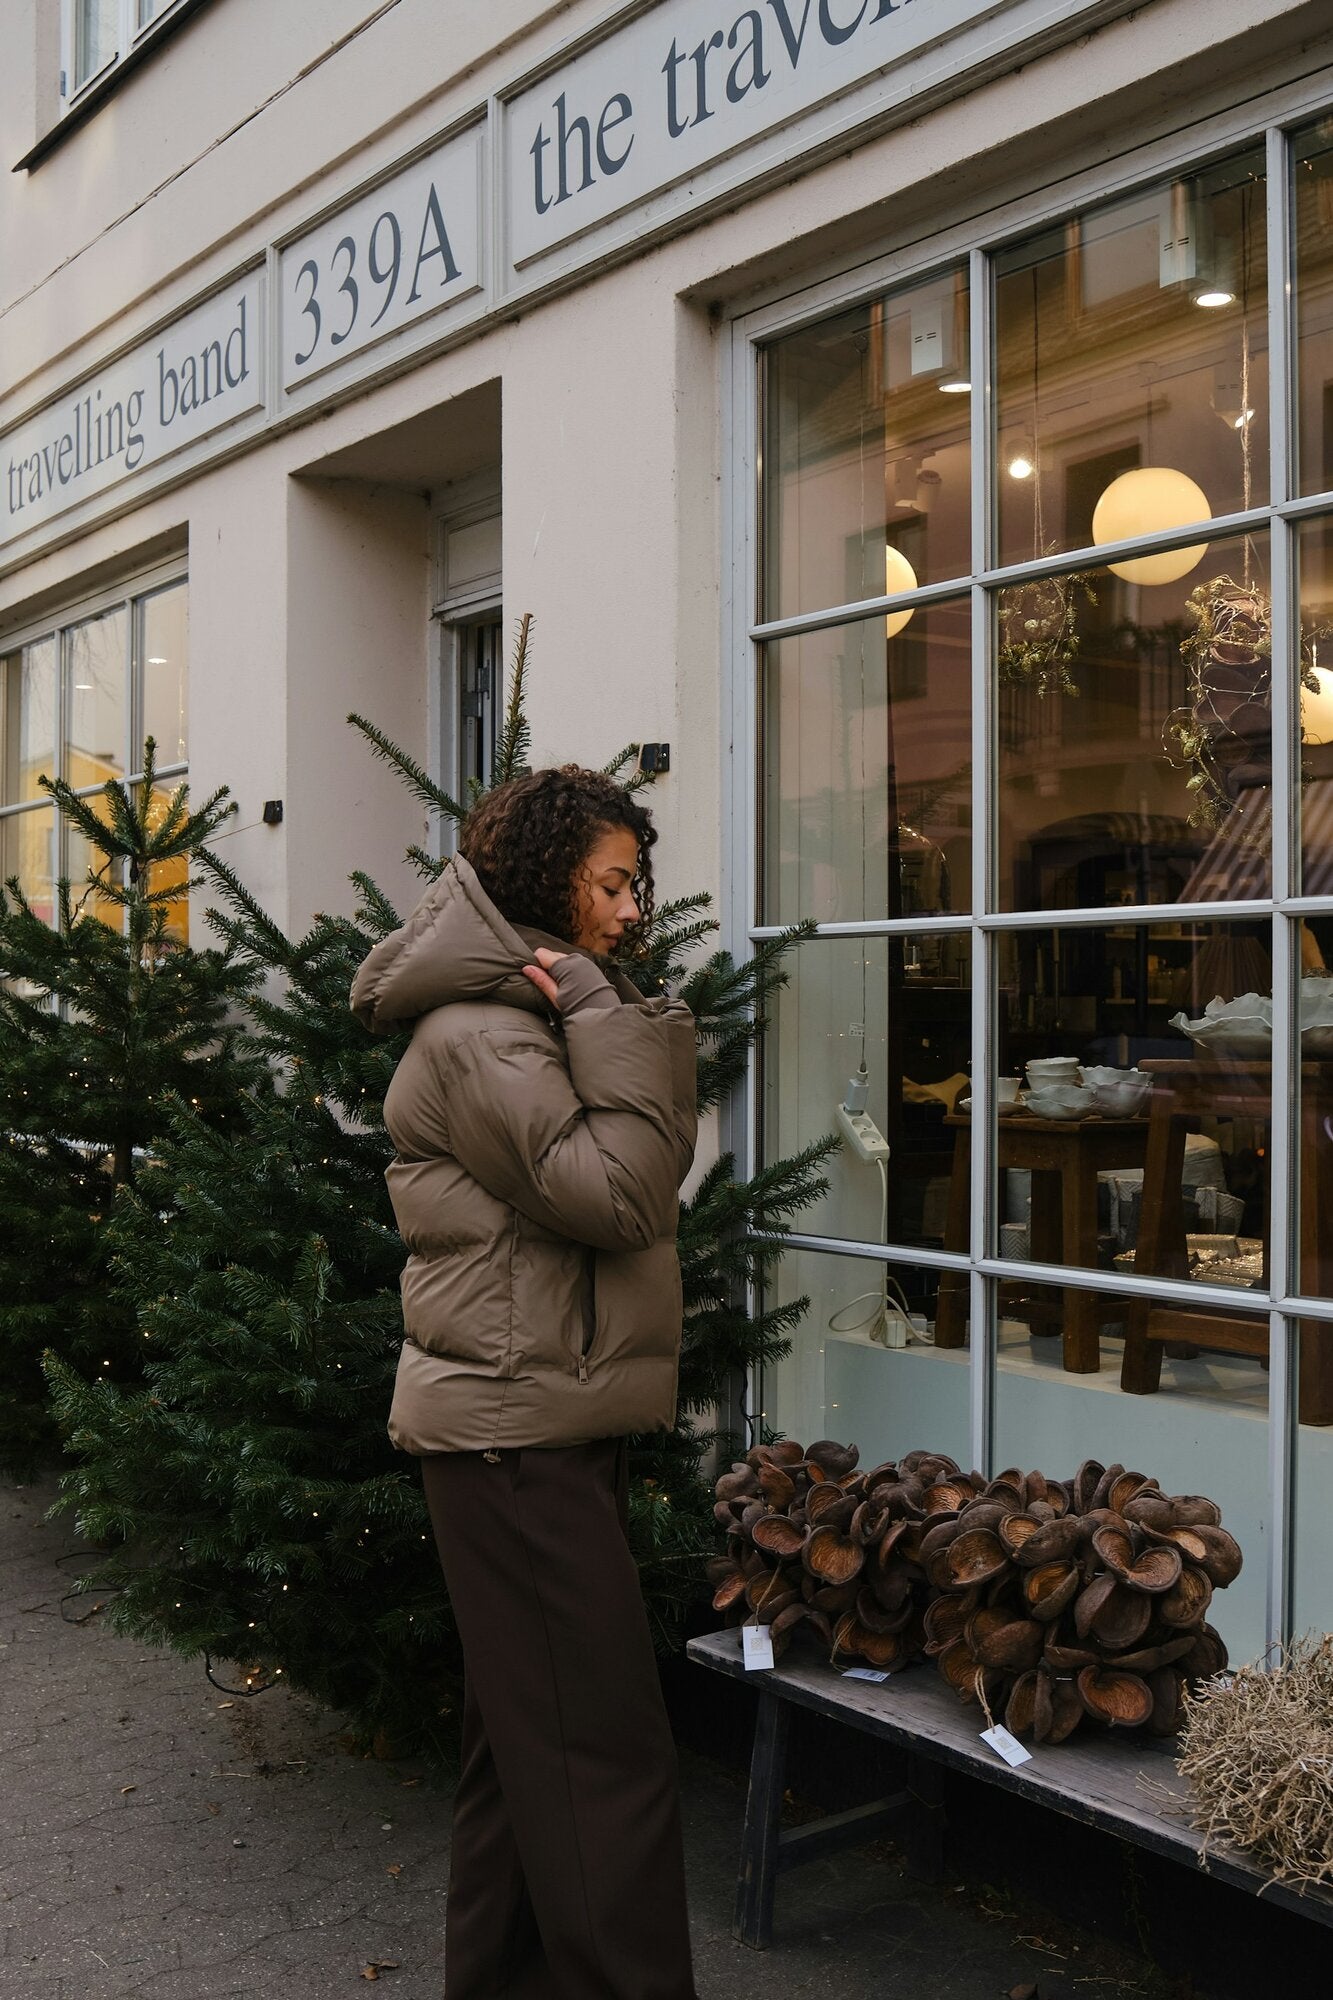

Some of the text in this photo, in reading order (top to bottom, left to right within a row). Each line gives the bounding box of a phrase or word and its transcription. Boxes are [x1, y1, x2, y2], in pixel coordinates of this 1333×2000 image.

[529, 91, 635, 215] the
[294, 182, 462, 365] 339A
[7, 295, 250, 515] travelling band
